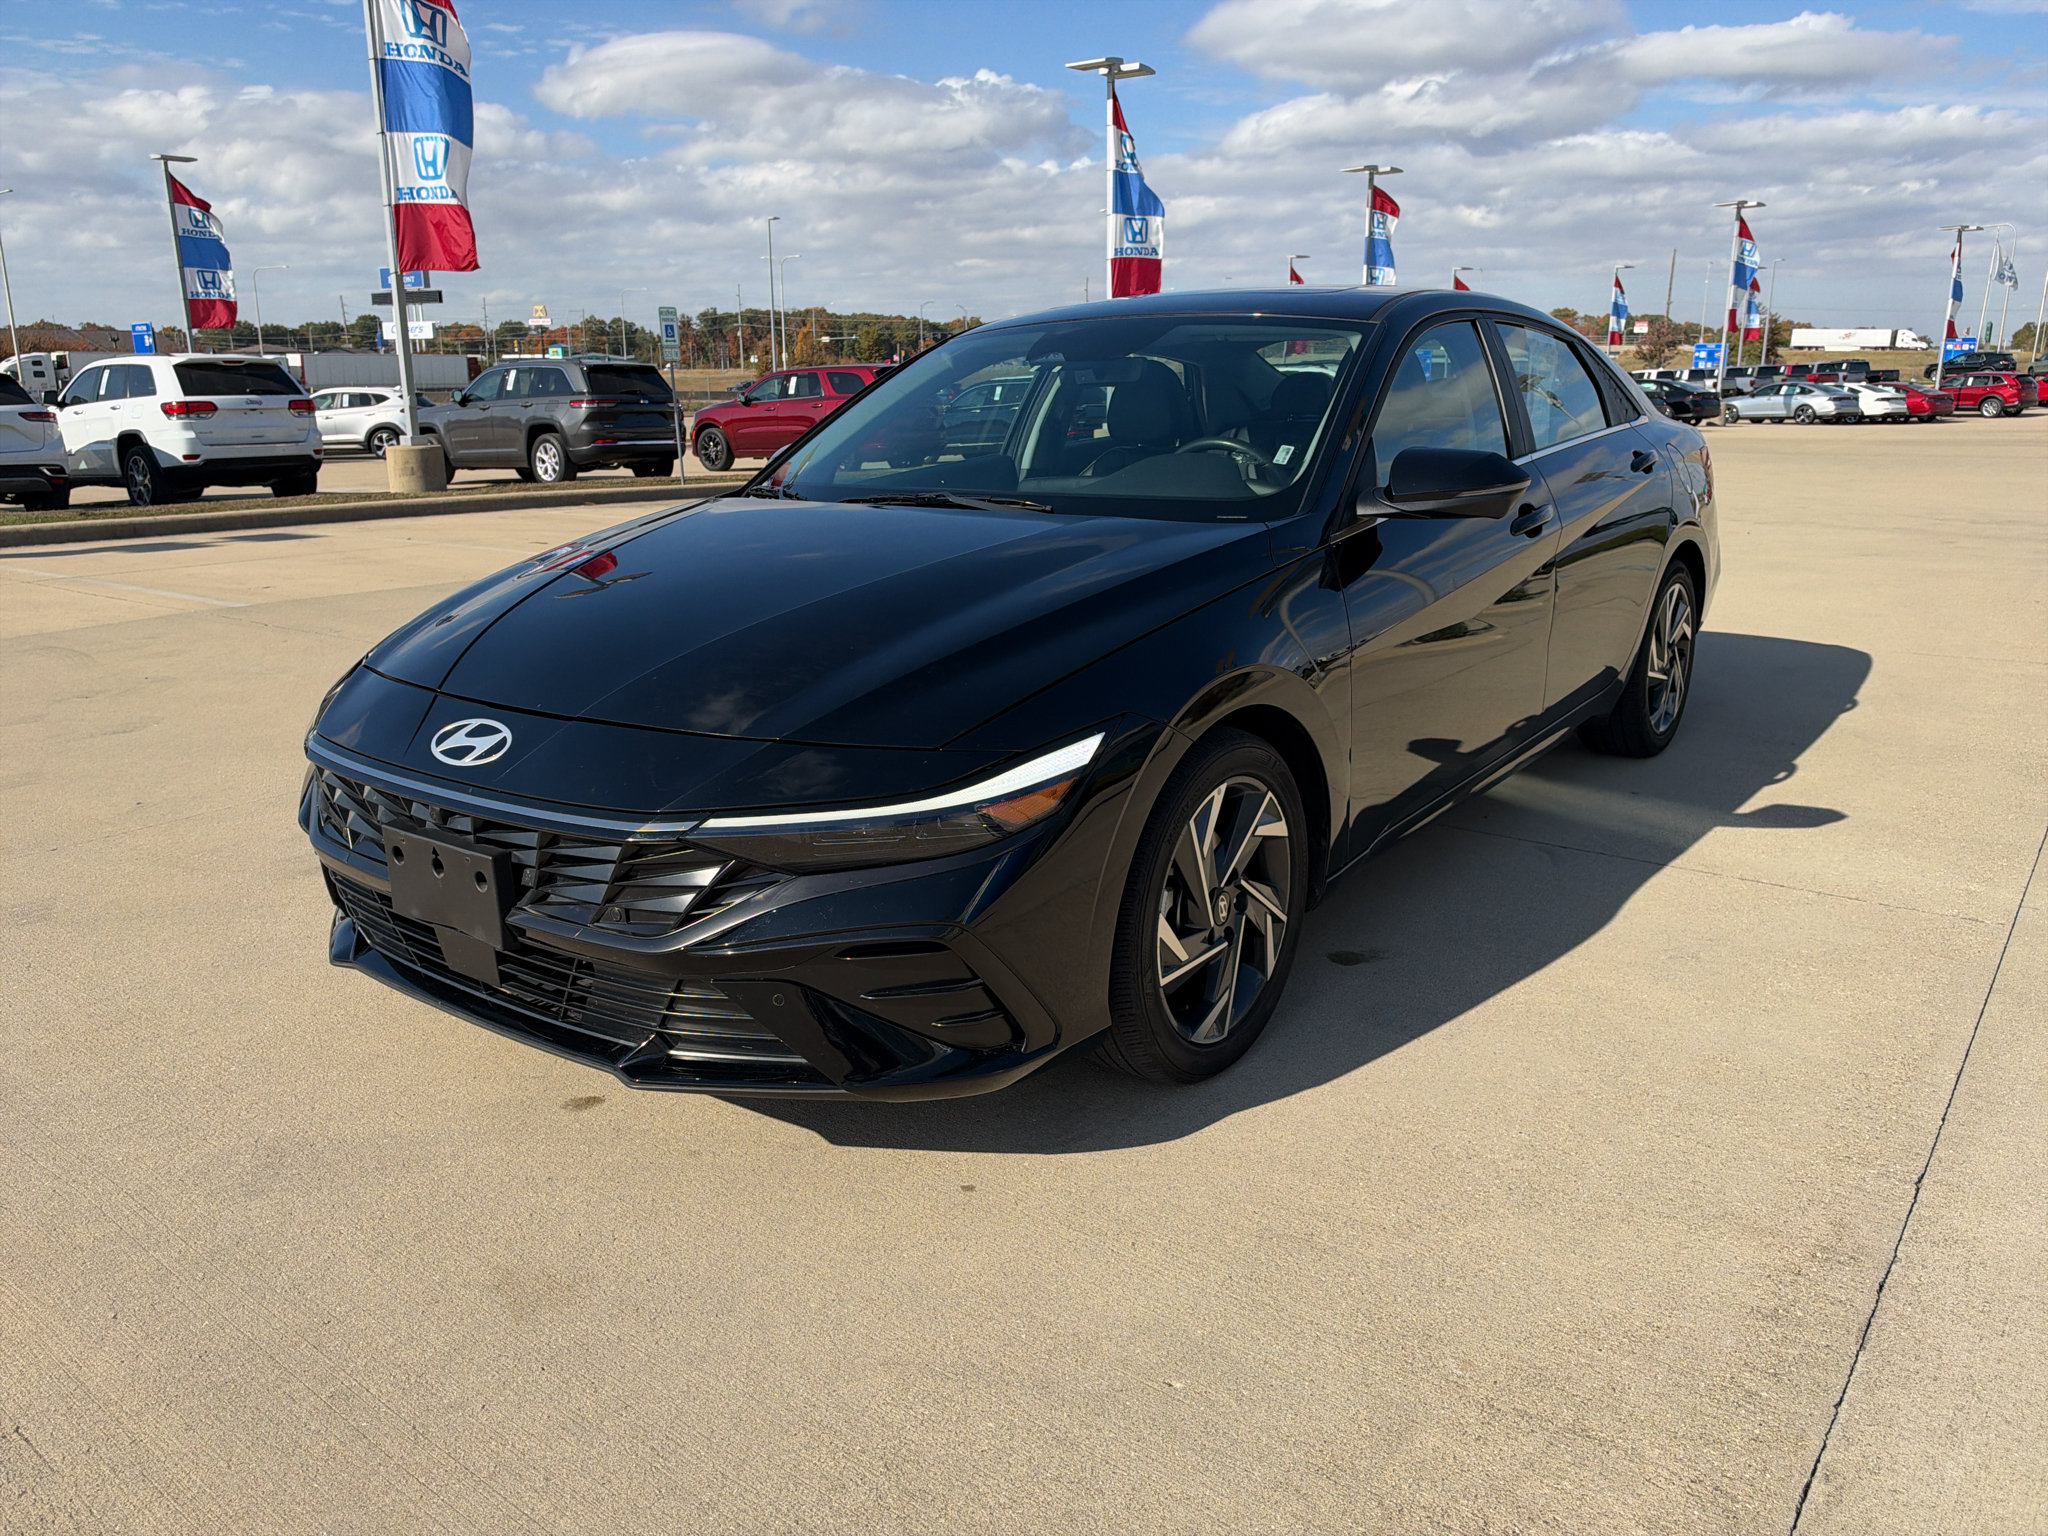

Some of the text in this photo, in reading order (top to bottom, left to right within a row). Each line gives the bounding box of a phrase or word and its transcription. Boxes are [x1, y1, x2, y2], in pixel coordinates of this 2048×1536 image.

[384, 41, 469, 77] HONDA
[182, 228, 219, 238] HOND
[1114, 247, 1159, 257] HONDA
